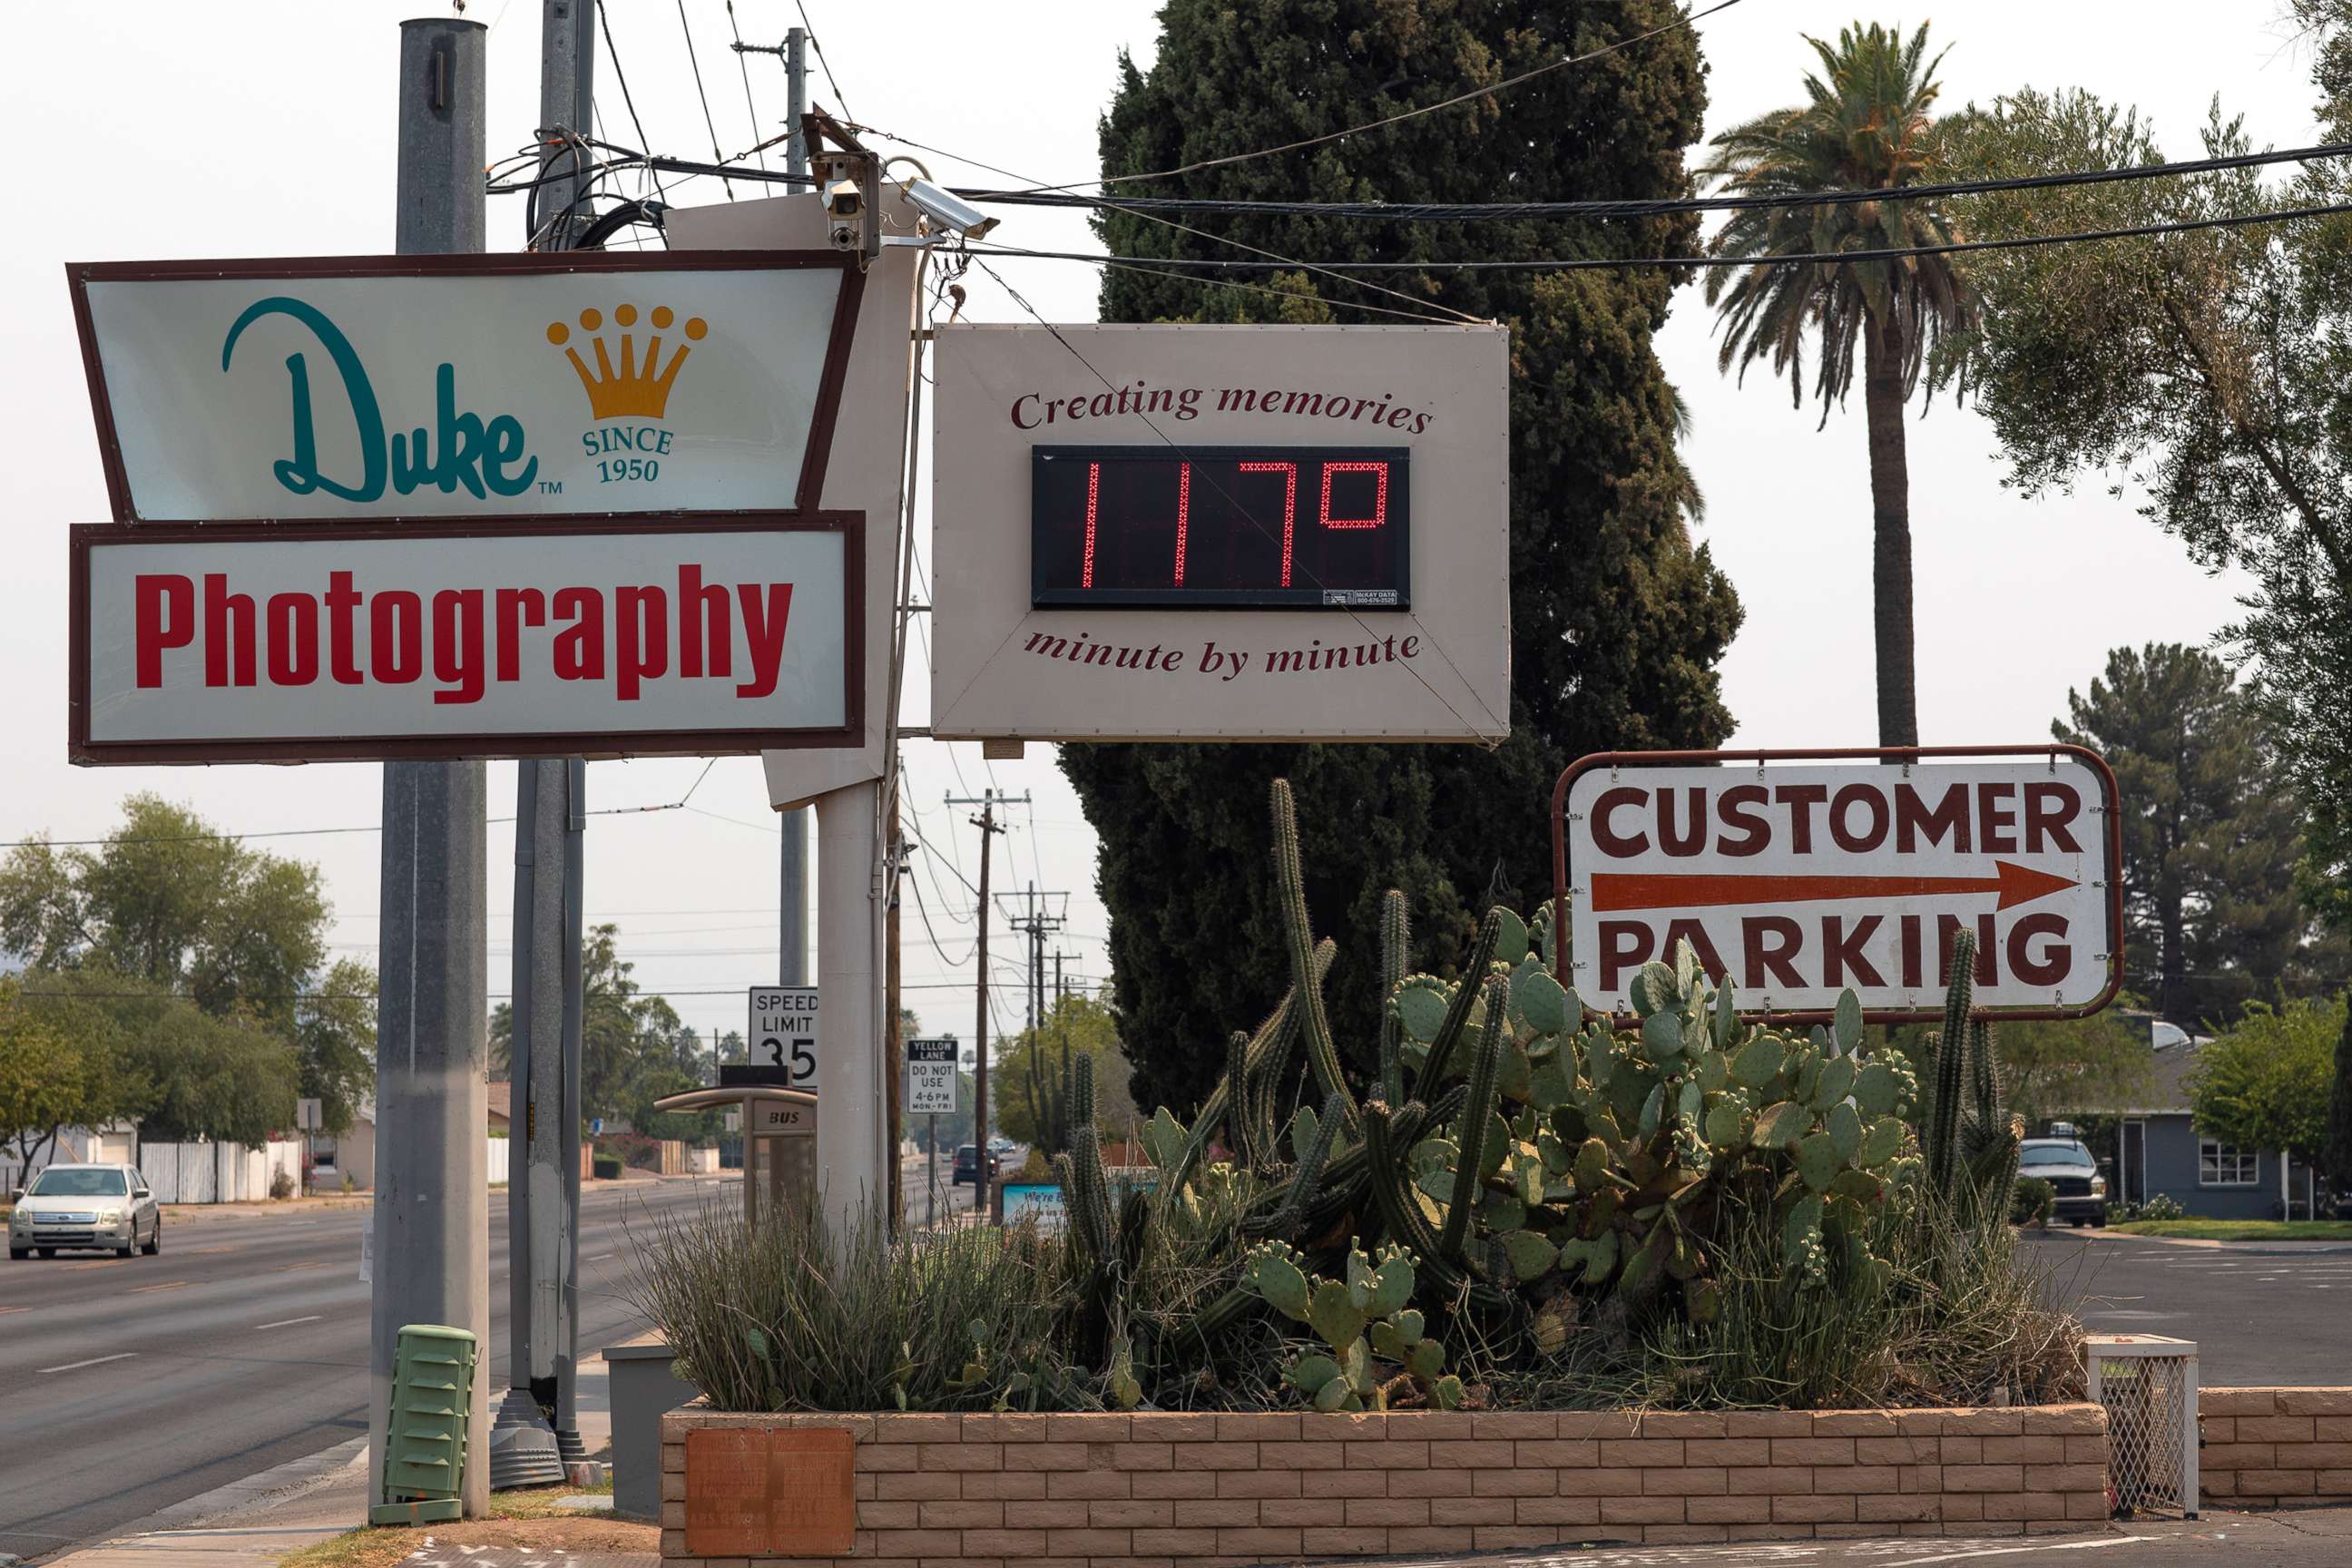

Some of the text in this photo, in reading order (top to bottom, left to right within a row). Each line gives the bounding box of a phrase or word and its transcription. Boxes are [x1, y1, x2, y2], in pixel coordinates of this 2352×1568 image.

[222, 297, 563, 502] Duke TM
[1010, 380, 1433, 436] Creating memories
[583, 426, 673, 456] SINCE
[597, 458, 660, 484] 1950
[136, 564, 793, 704] Photography
[1024, 631, 1422, 681] minute by minute
[1590, 782, 2084, 858] CUSTOMER
[1598, 913, 2073, 992] PARKING
[756, 995, 818, 1011] SPEED
[763, 1016, 812, 1033] LIMIT
[761, 1037, 816, 1080] 35
[914, 1042, 952, 1051] YELLOW
[920, 1052, 946, 1060] LANE
[912, 1065, 953, 1076] DO NOT
[921, 1077, 944, 1088] USE
[769, 1111, 799, 1124] BUS
